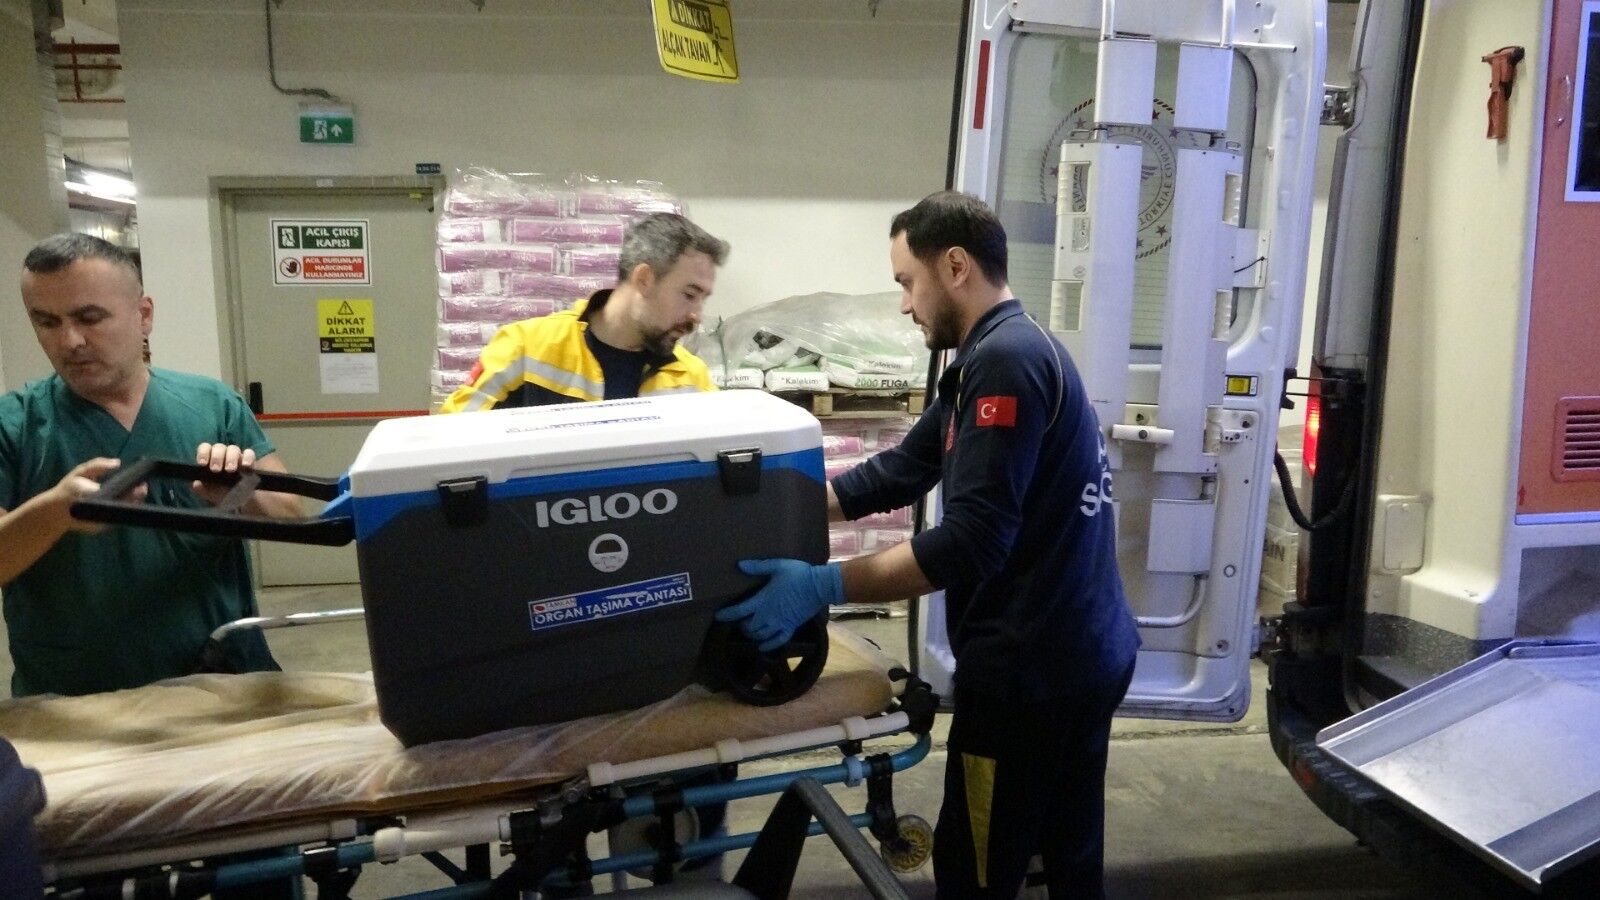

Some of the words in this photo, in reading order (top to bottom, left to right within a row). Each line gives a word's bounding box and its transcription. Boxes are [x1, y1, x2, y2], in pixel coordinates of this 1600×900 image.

[662, 27, 687, 58] ALÇAK
[684, 36, 712, 63] TAVAN
[326, 317, 366, 325] DİKKAT
[328, 327, 365, 335] ALARM
[881, 379, 909, 388] FUGA
[535, 488, 678, 528] IGLOO
[534, 607, 583, 624] ORGAN
[586, 598, 633, 614] TAŞIMA
[635, 586, 688, 606] ÇANTASI
